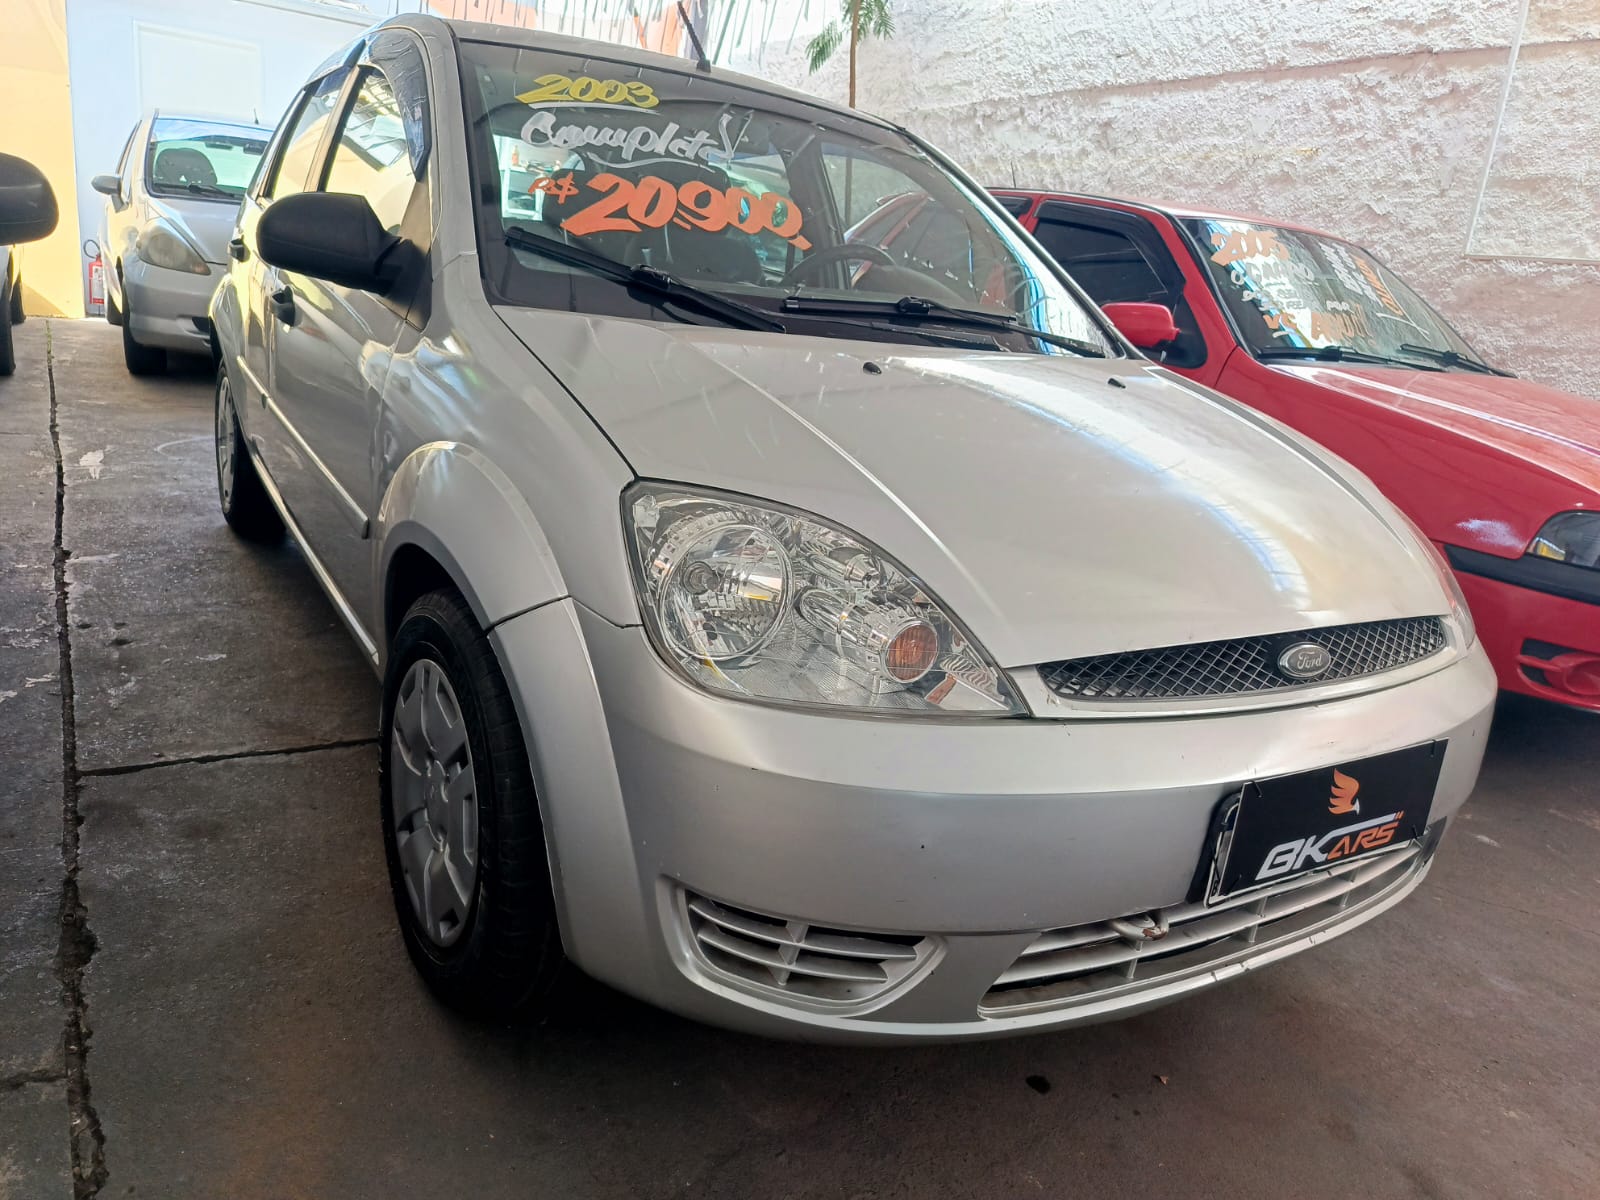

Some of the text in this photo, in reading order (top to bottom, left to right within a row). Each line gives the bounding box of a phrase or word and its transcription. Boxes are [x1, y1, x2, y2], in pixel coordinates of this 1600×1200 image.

[514, 74, 660, 108] 2003
[528, 171, 580, 204] R$
[1296, 650, 1323, 670] Ford
